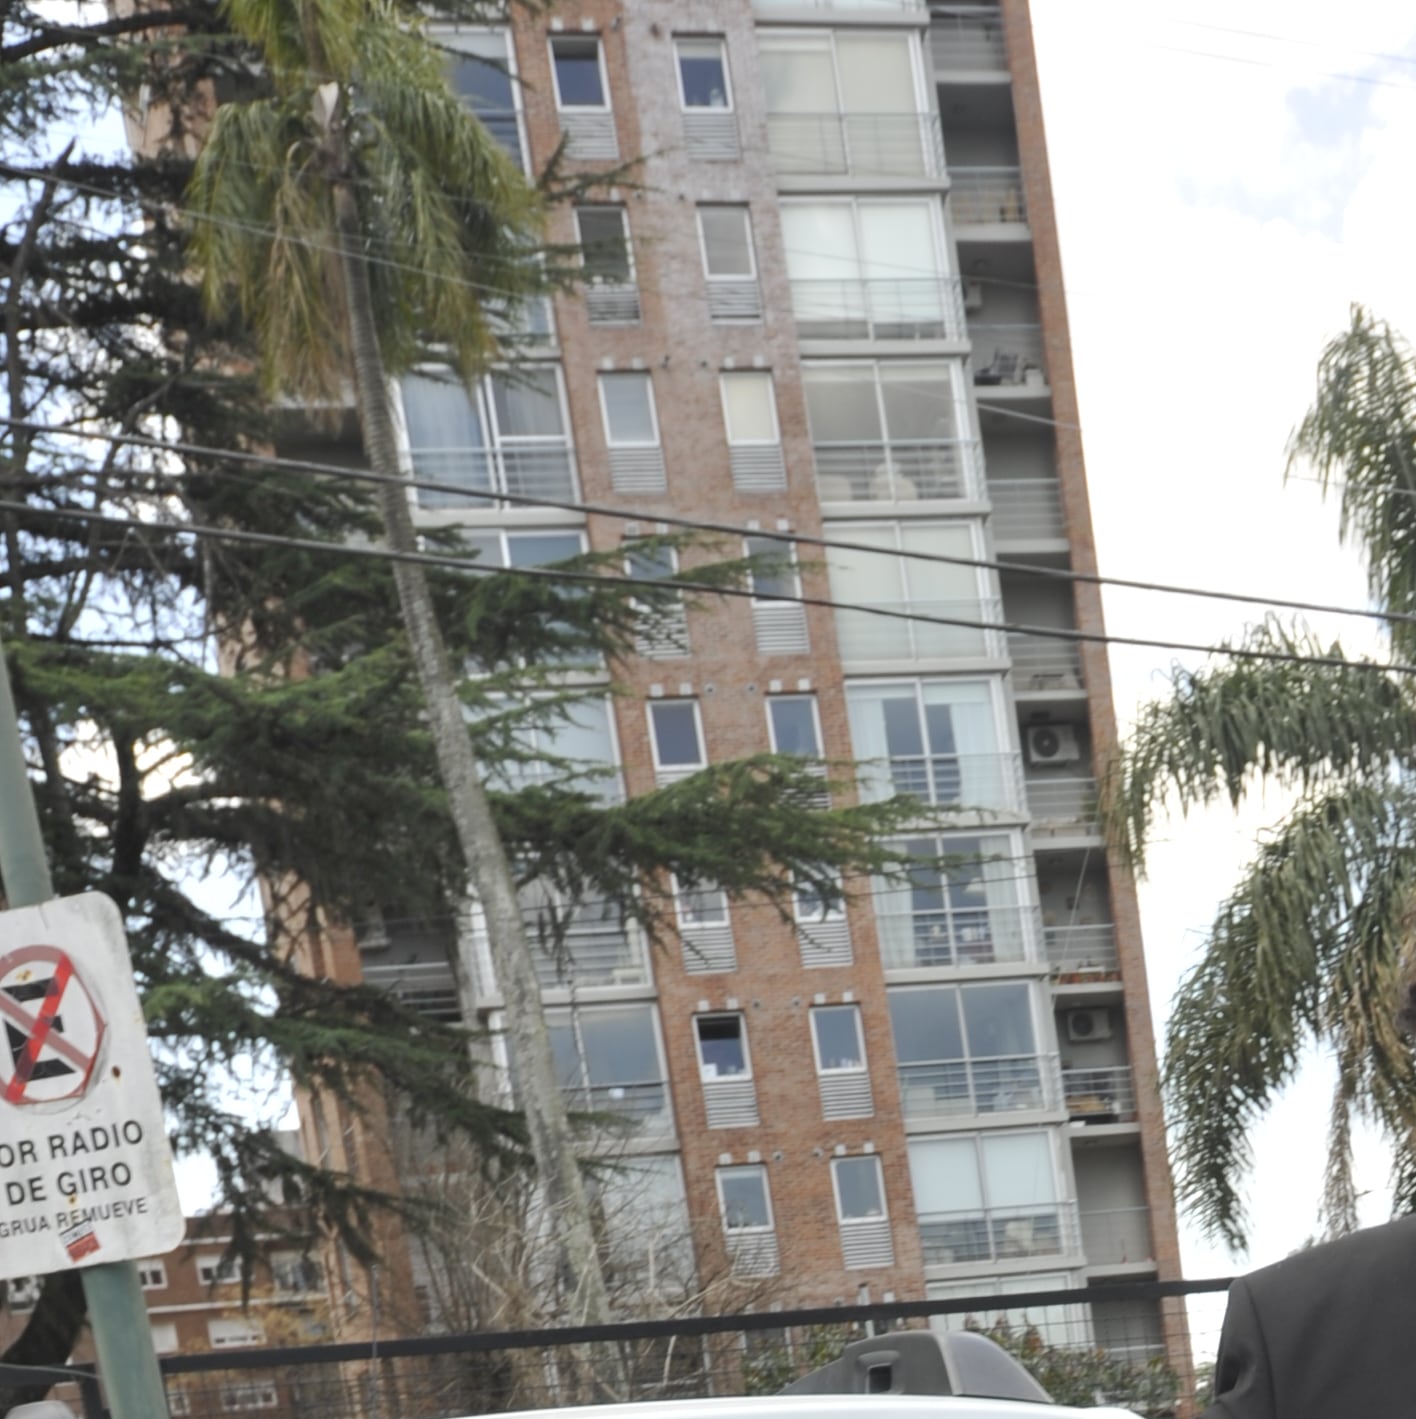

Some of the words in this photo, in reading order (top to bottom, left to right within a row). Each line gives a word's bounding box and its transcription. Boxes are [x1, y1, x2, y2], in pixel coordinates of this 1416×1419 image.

[48, 1120, 143, 1159] RADIO
[5, 1176, 47, 1207] DE
[57, 1162, 132, 1196] GIRO
[0, 1215, 50, 1238] GRUA
[56, 1197, 149, 1229] REMUEVE
